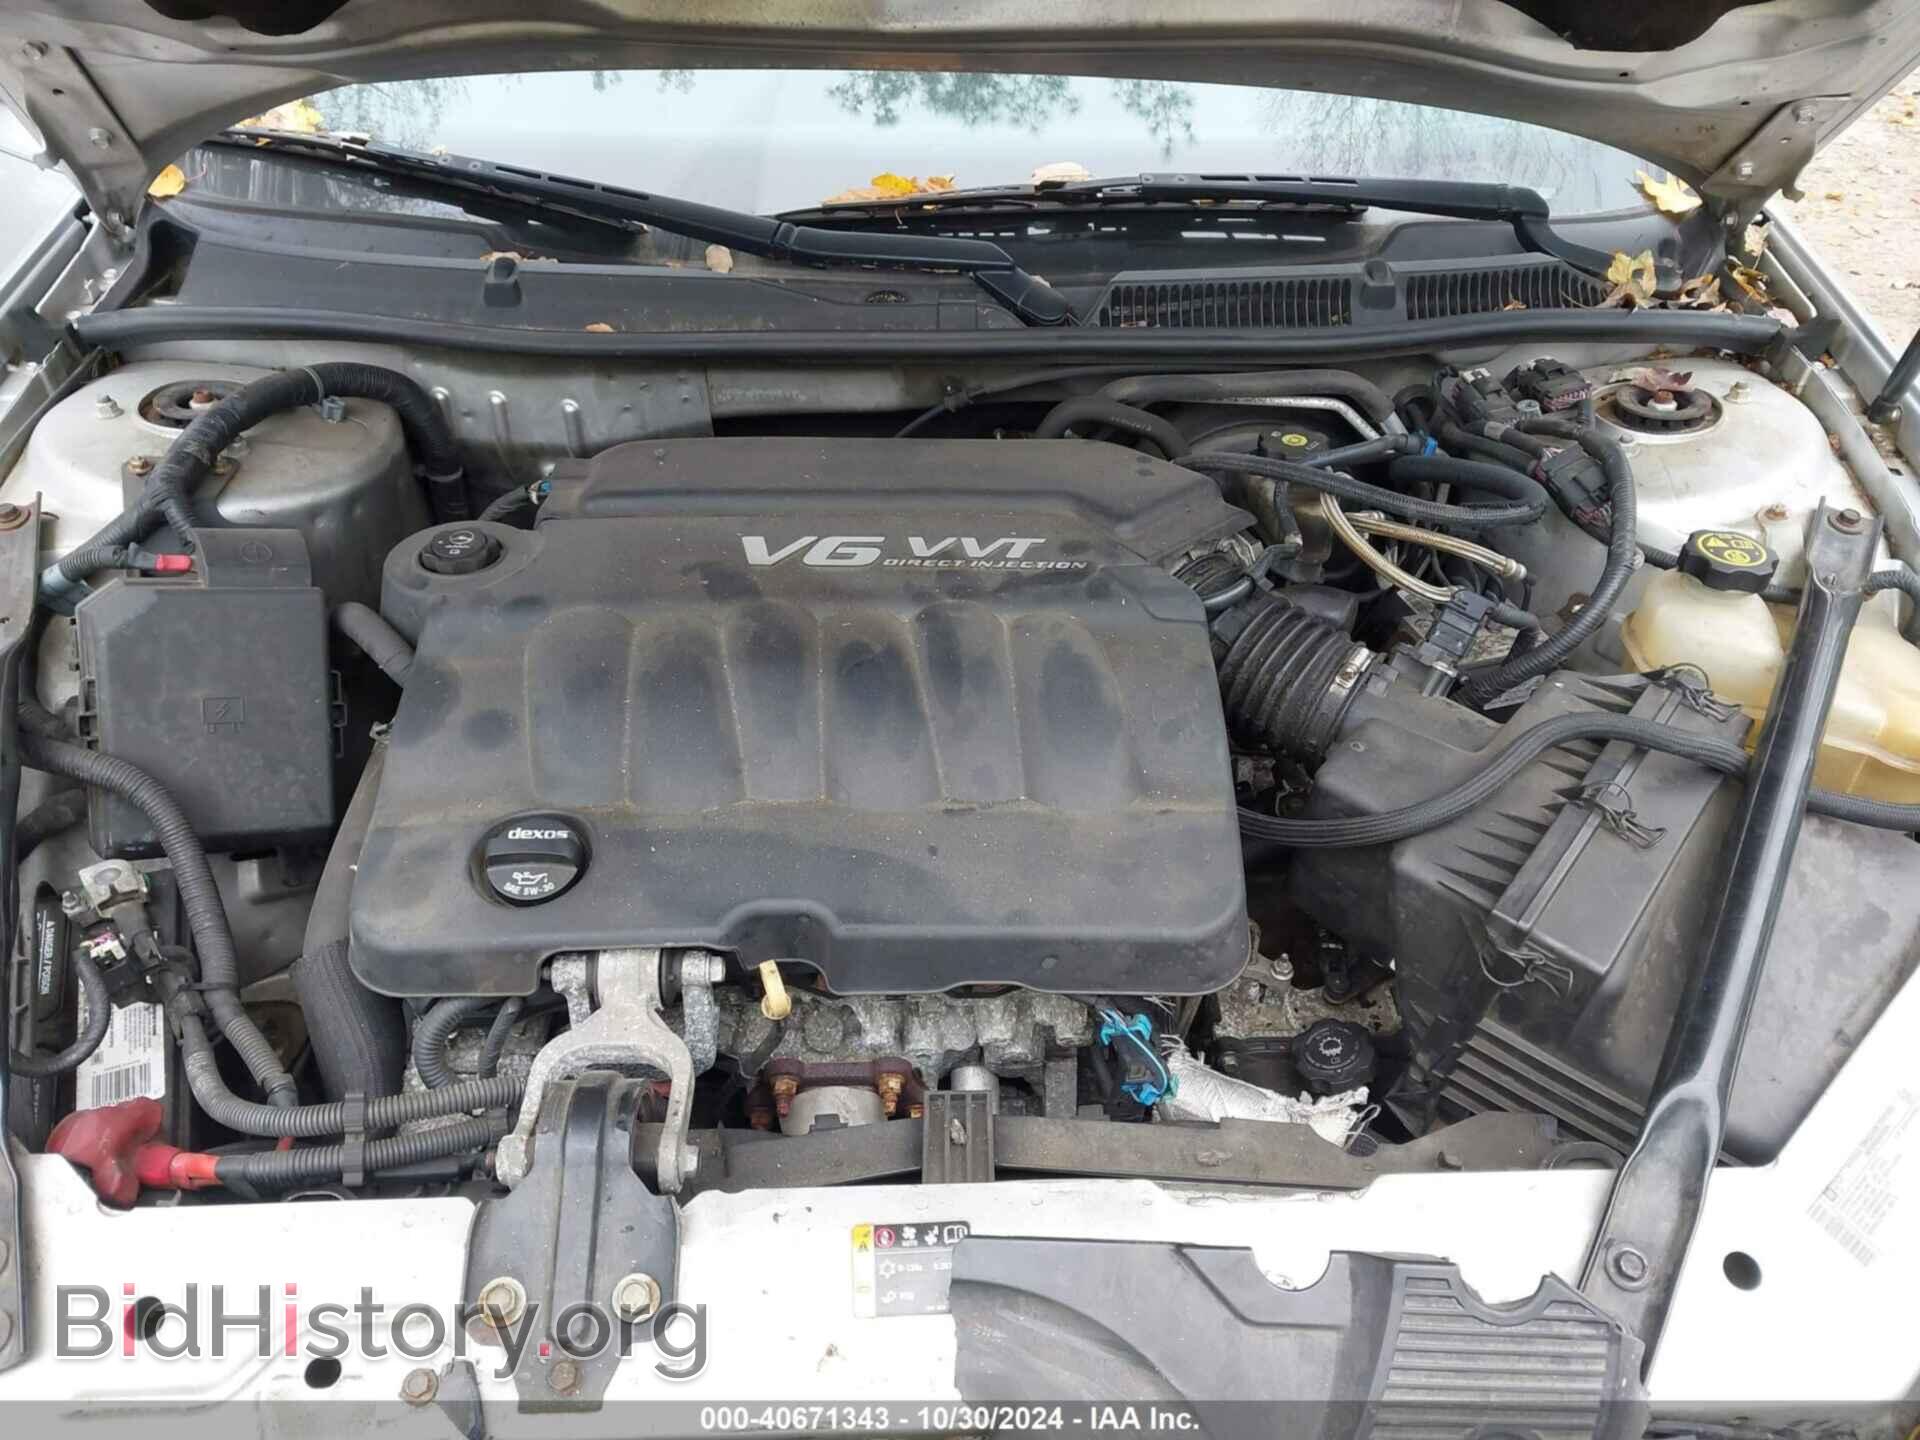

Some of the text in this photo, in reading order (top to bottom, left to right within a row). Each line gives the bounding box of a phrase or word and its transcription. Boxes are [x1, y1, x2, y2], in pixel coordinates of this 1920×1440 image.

[741, 536, 1047, 567] V6 VVT
[882, 558, 1088, 570] DIRECT INJECTION
[508, 827, 569, 840] dexos
